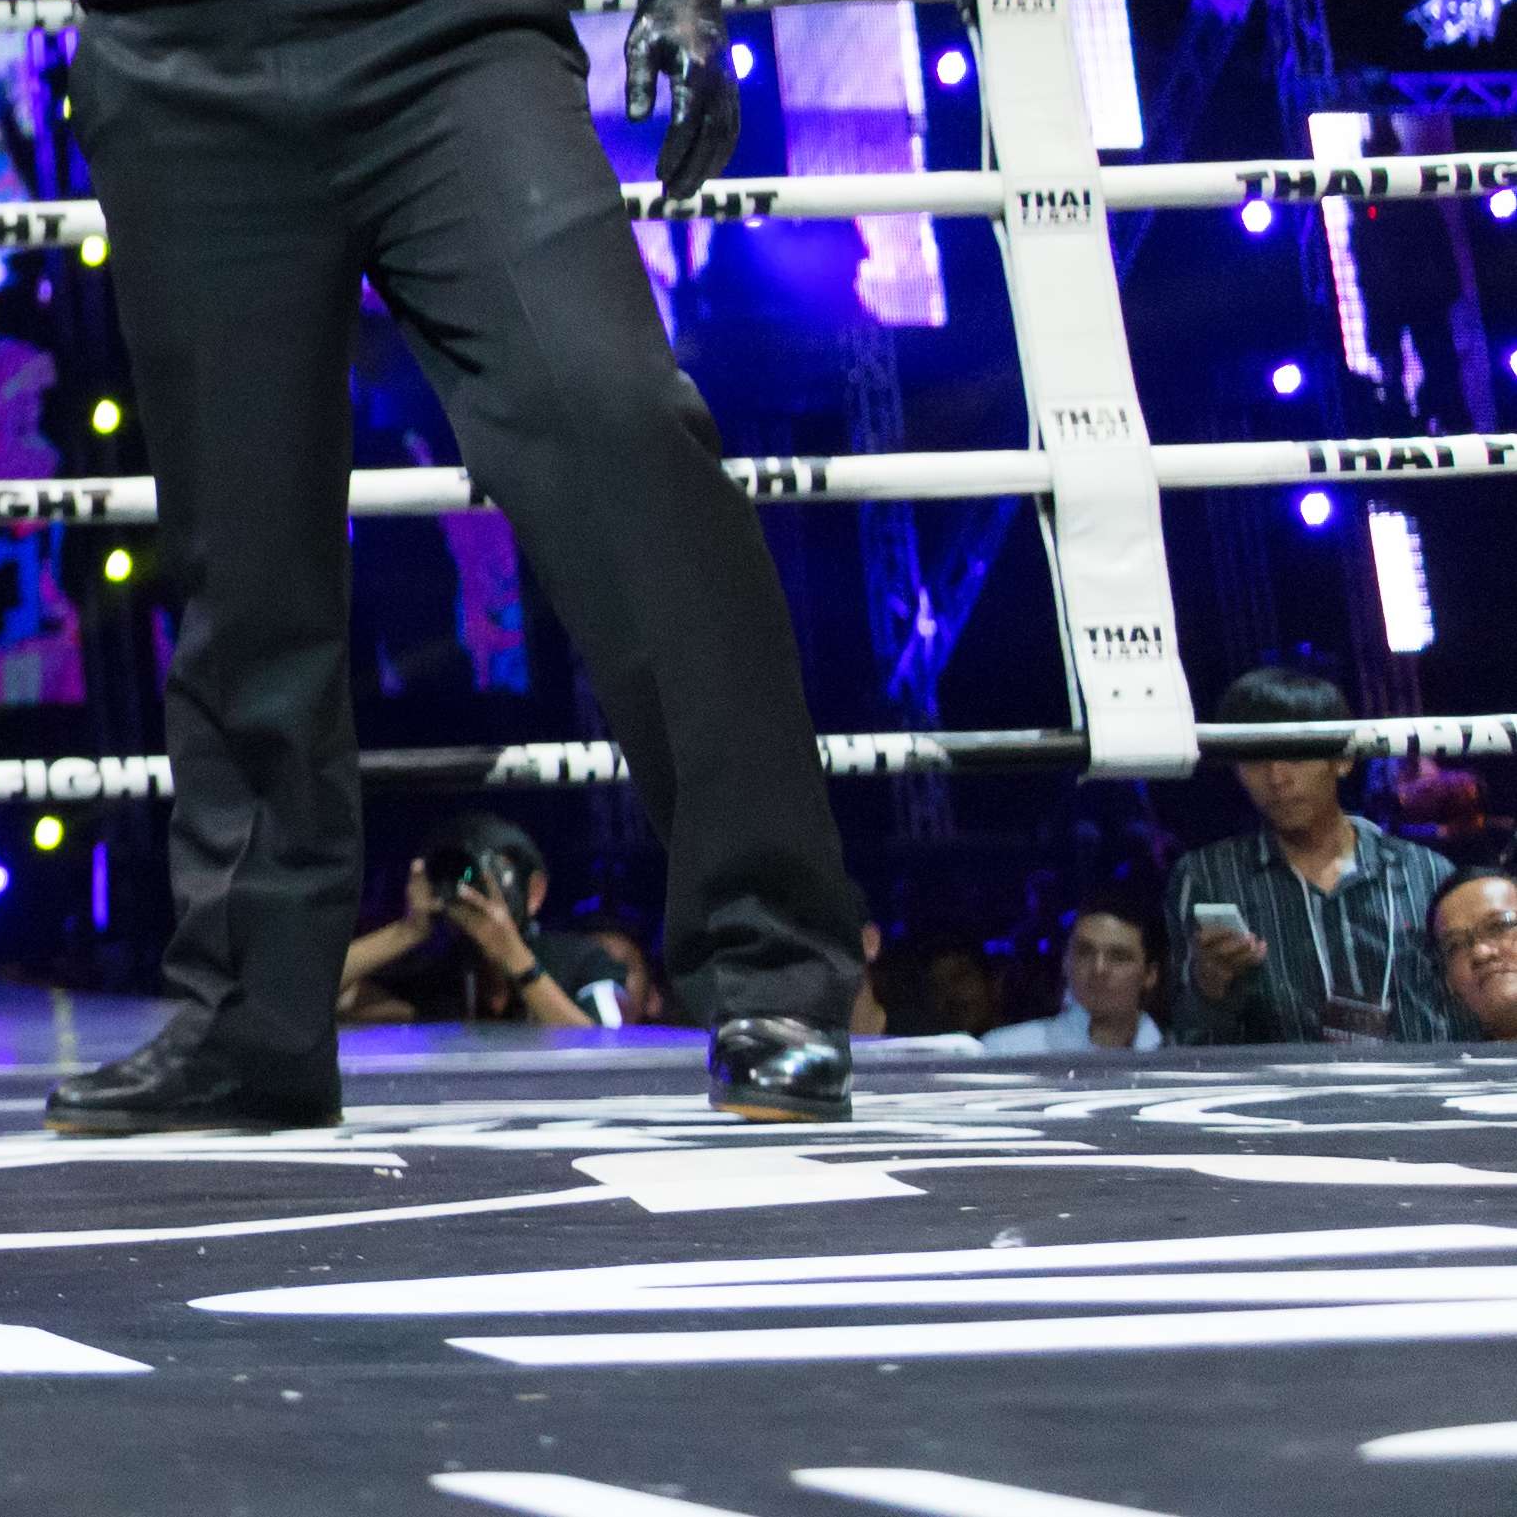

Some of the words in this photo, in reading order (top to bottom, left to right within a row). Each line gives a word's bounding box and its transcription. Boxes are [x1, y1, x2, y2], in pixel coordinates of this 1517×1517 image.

[1235, 167, 1389, 198] THAI
[1420, 162, 1517, 195] FIG
[625, 191, 778, 221] IGHT
[1016, 190, 1091, 207] THAI
[1083, 626, 1162, 642] THAI
[1376, 715, 1517, 756] THA
